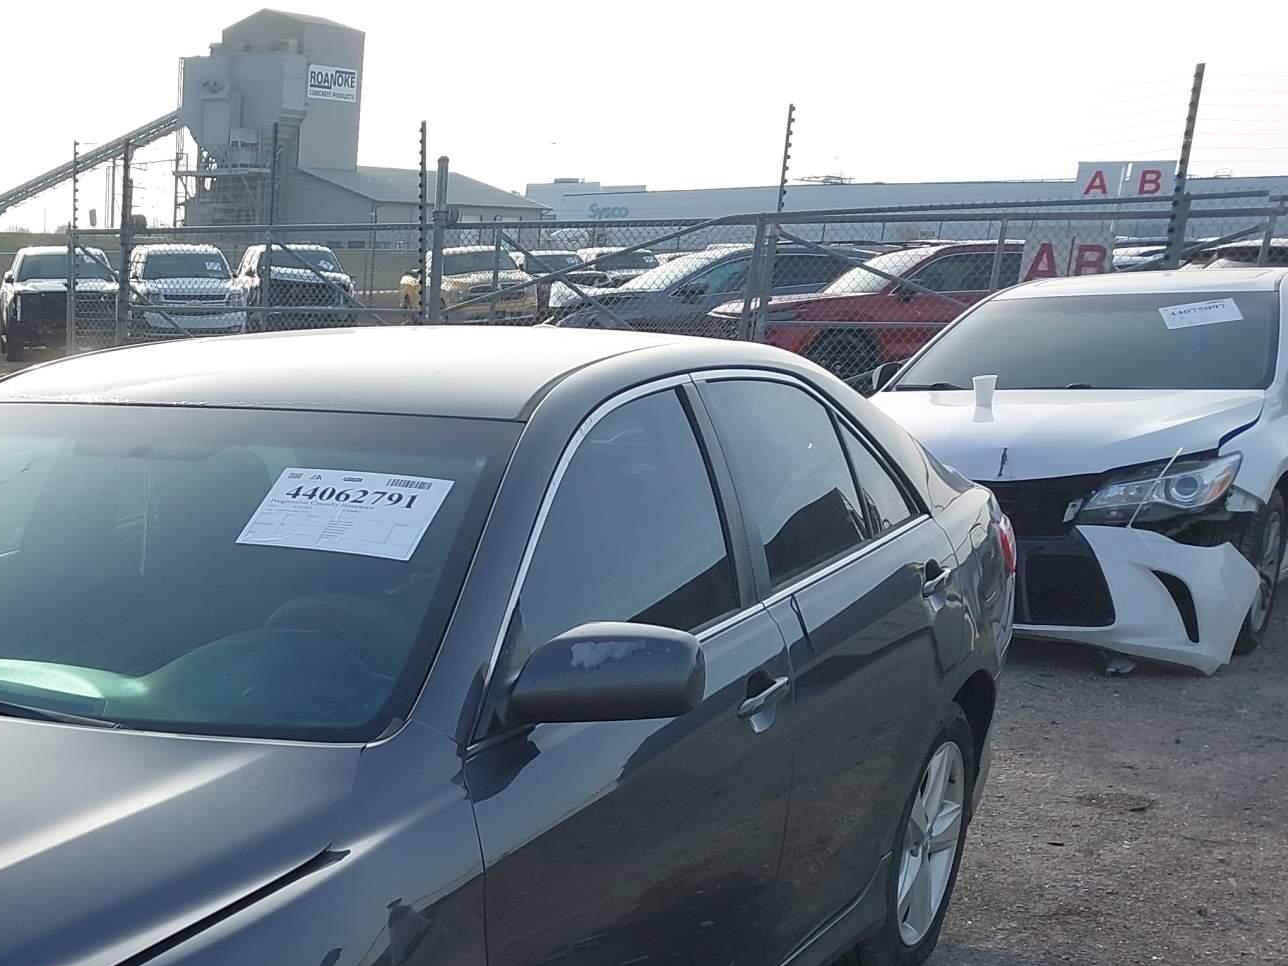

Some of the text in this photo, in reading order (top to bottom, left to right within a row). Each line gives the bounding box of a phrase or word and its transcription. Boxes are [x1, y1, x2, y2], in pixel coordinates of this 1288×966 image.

[310, 70, 355, 88] ROANOKE
[309, 90, 332, 98] CONCRETE
[1083, 169, 1162, 195] A B
[589, 203, 629, 220] Sysco
[1024, 242, 1058, 281] A
[285, 485, 418, 508] 44062791
